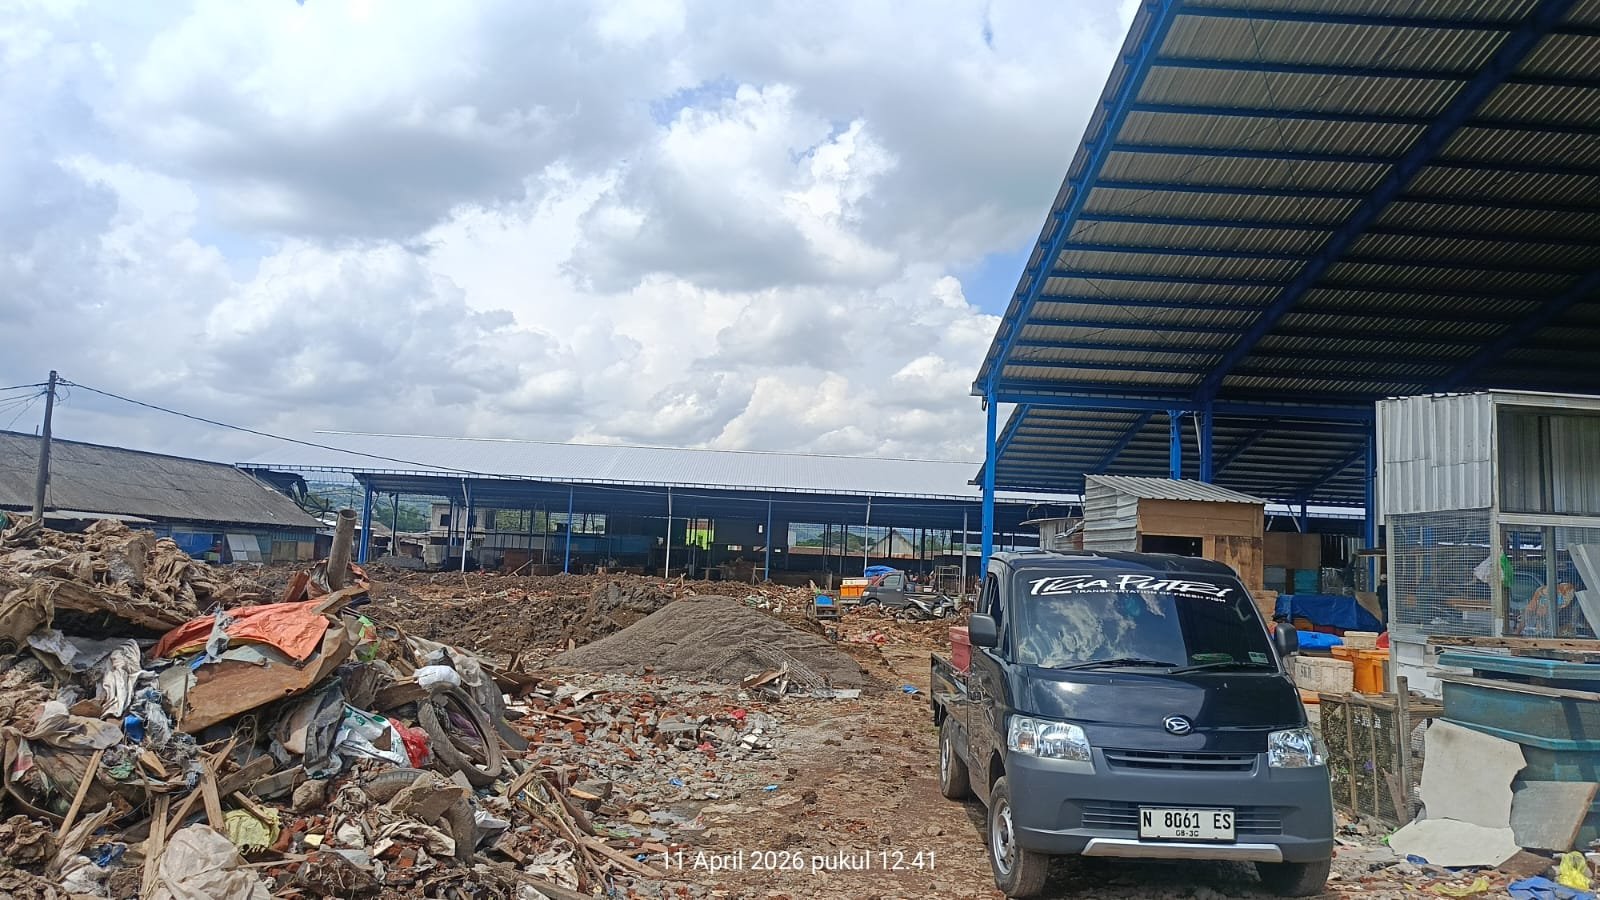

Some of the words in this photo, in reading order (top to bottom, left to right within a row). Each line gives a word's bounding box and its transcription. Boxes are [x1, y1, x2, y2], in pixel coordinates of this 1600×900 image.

[1143, 811, 1152, 828] N
[1164, 811, 1200, 830] 8061
[1213, 813, 1231, 830] ES
